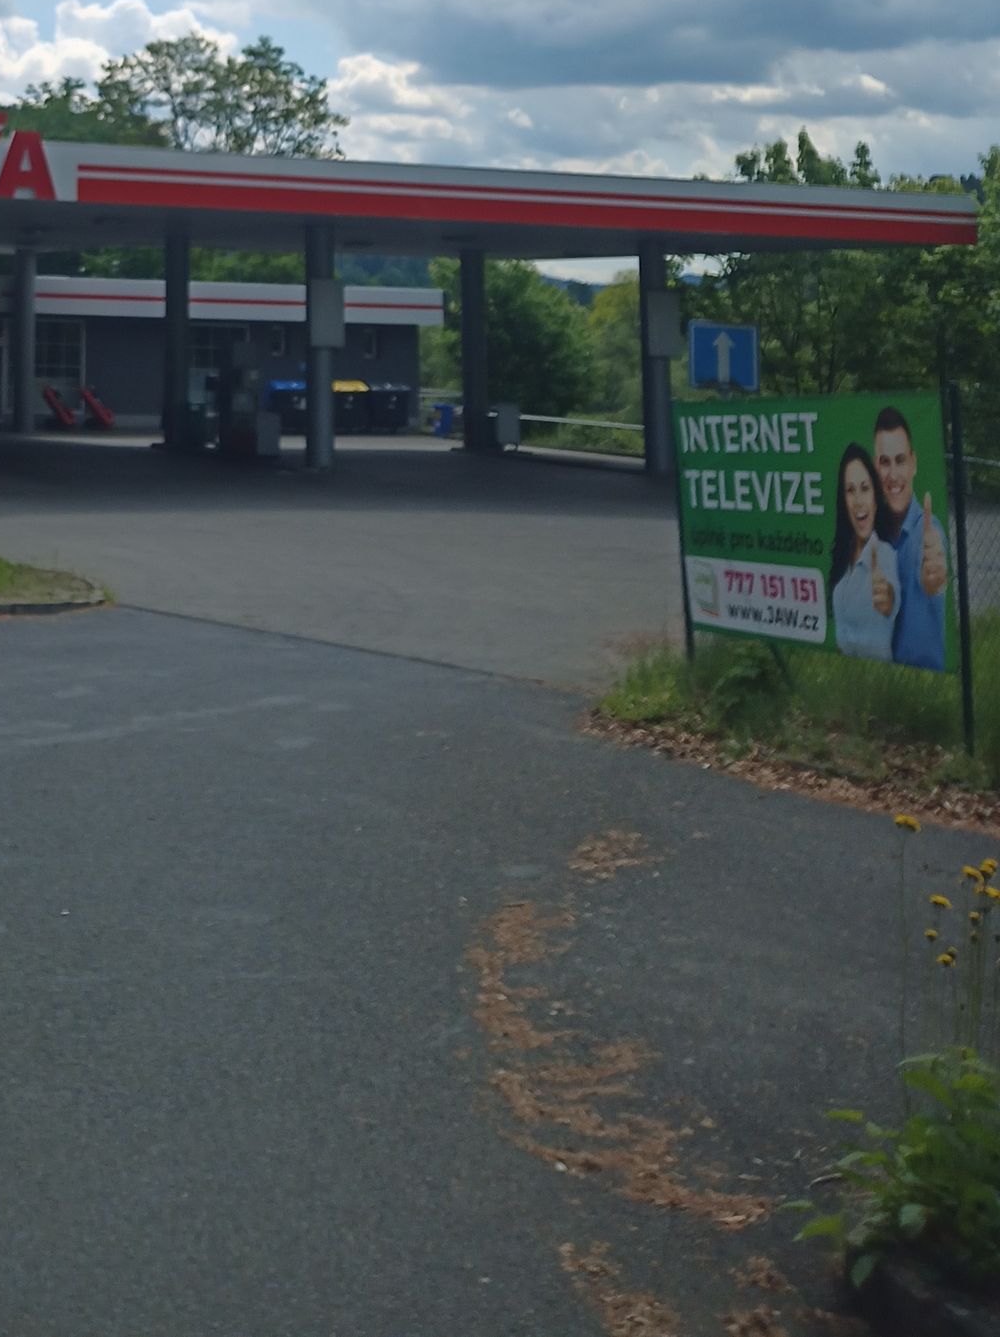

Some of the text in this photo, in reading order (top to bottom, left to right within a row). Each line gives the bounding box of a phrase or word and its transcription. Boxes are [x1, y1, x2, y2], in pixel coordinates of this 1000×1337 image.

[680, 412, 818, 454] INTERNET
[685, 470, 825, 515] TELEVIZE
[724, 569, 755, 595] 777
[761, 573, 786, 599] 151
[791, 577, 818, 602] 151
